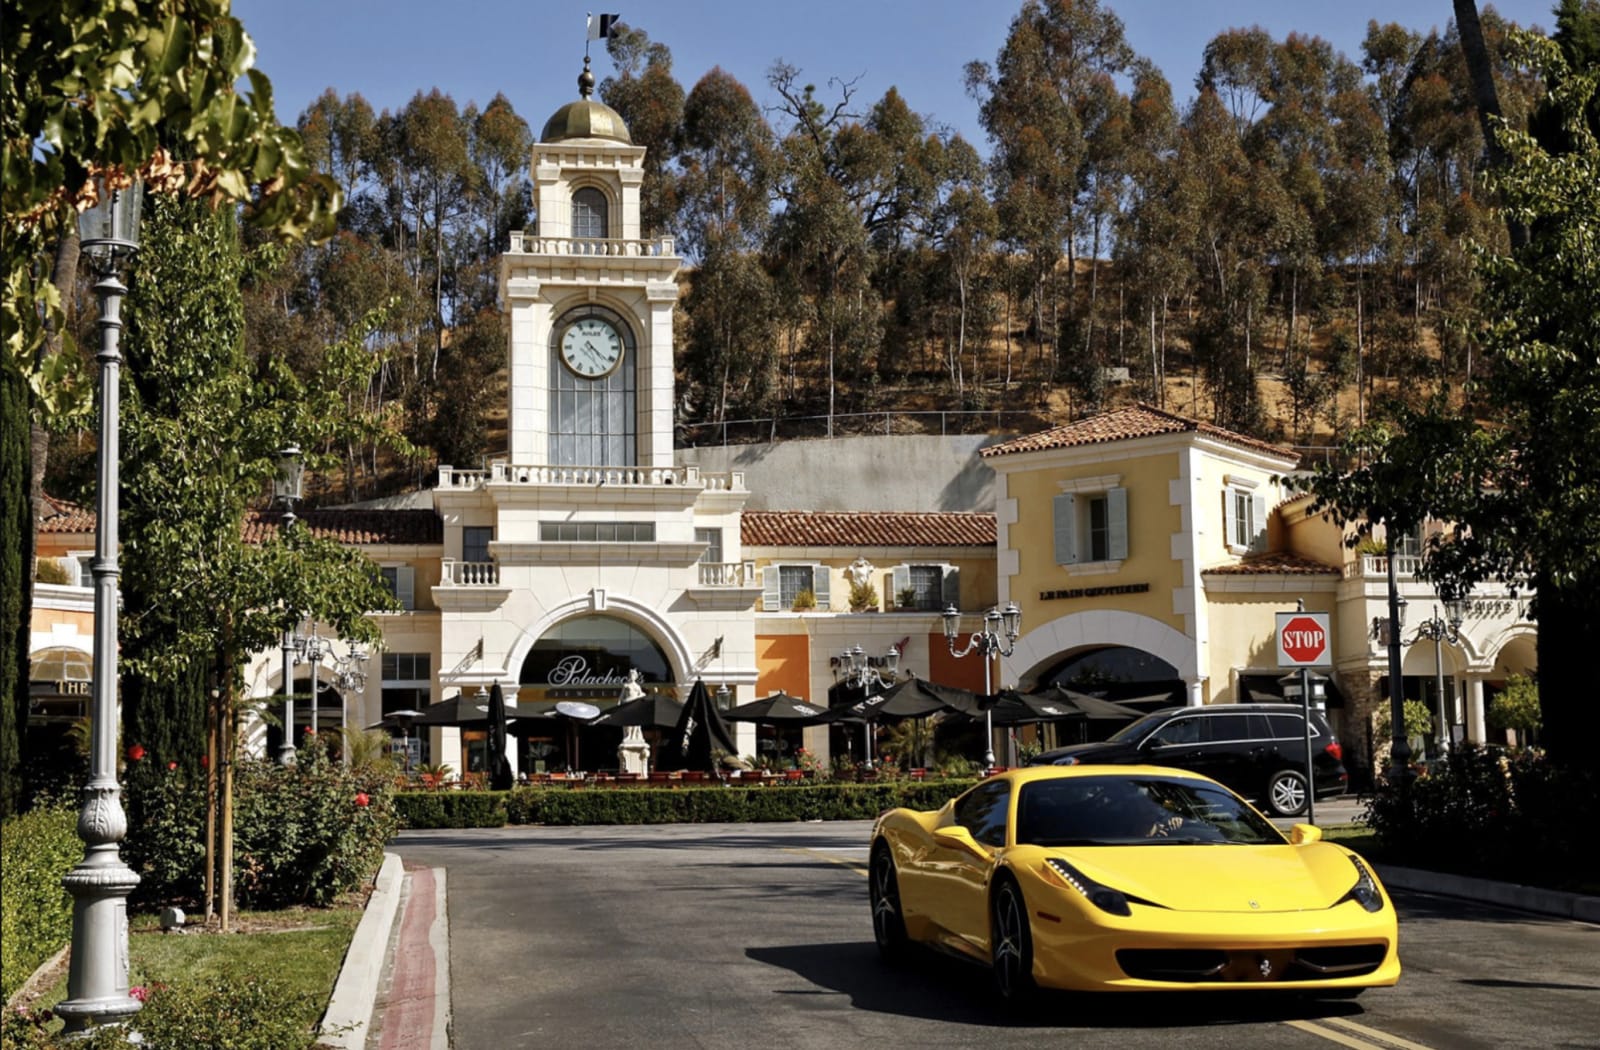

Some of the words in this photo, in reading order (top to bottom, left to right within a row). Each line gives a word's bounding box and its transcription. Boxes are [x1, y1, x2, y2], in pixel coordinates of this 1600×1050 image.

[1284, 630, 1324, 649] STOP
[547, 655, 644, 687] Polachec's
[55, 680, 89, 695] THE
